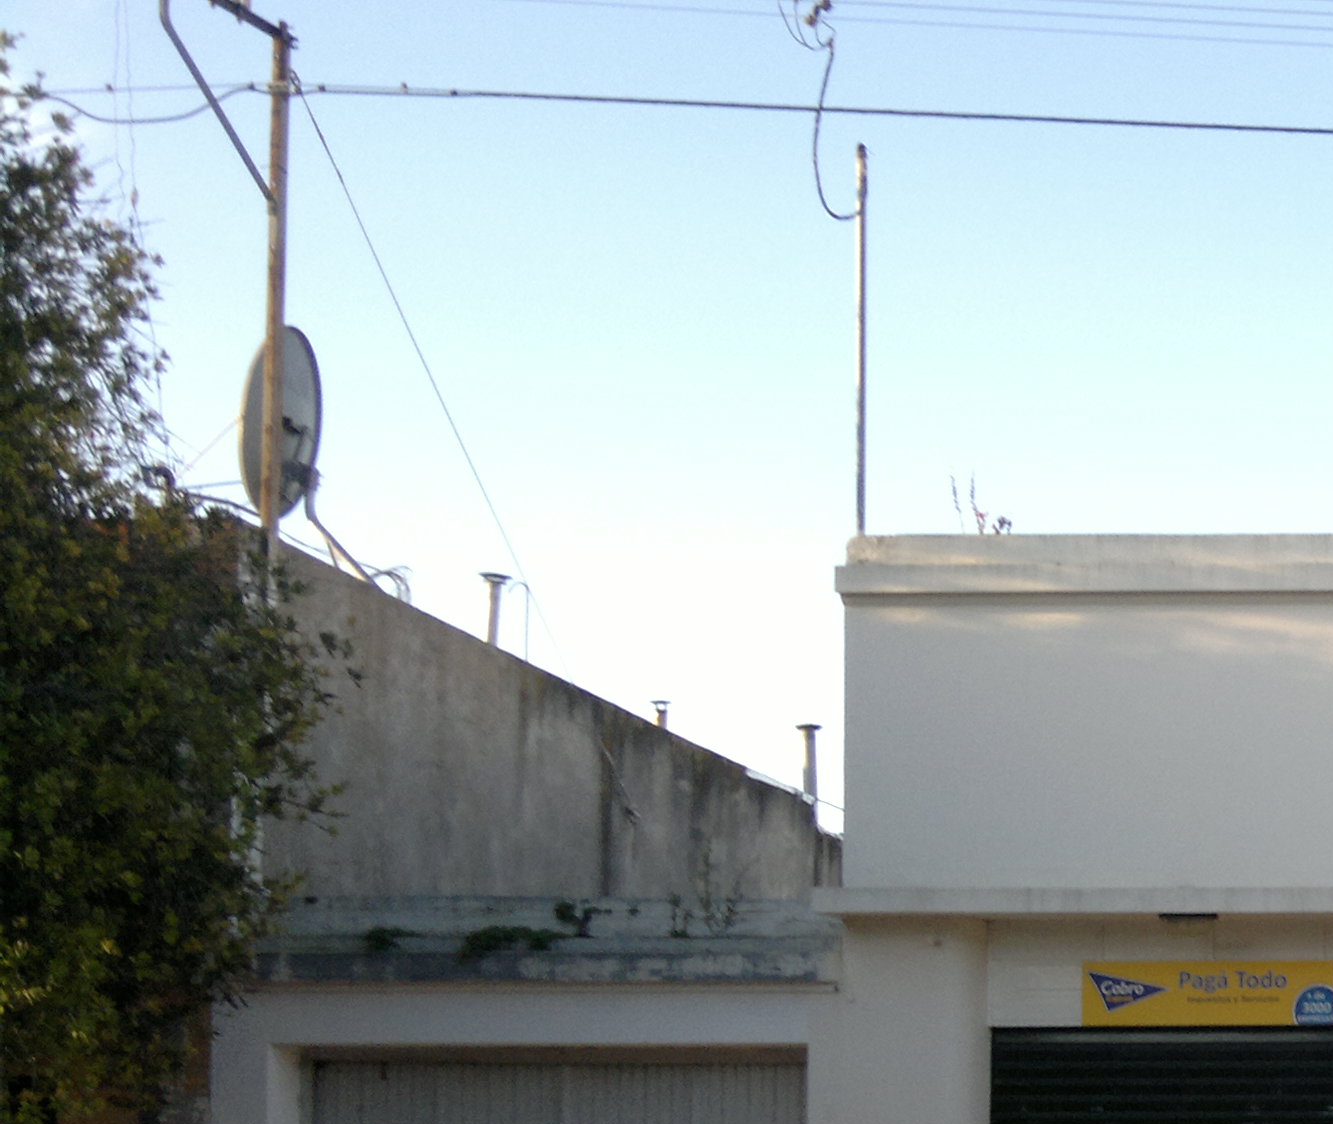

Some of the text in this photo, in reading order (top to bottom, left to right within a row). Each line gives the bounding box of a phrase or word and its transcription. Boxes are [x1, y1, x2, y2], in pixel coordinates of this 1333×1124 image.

[1100, 978, 1144, 995] Cobro
[1178, 970, 1287, 993] Pagá Todo
